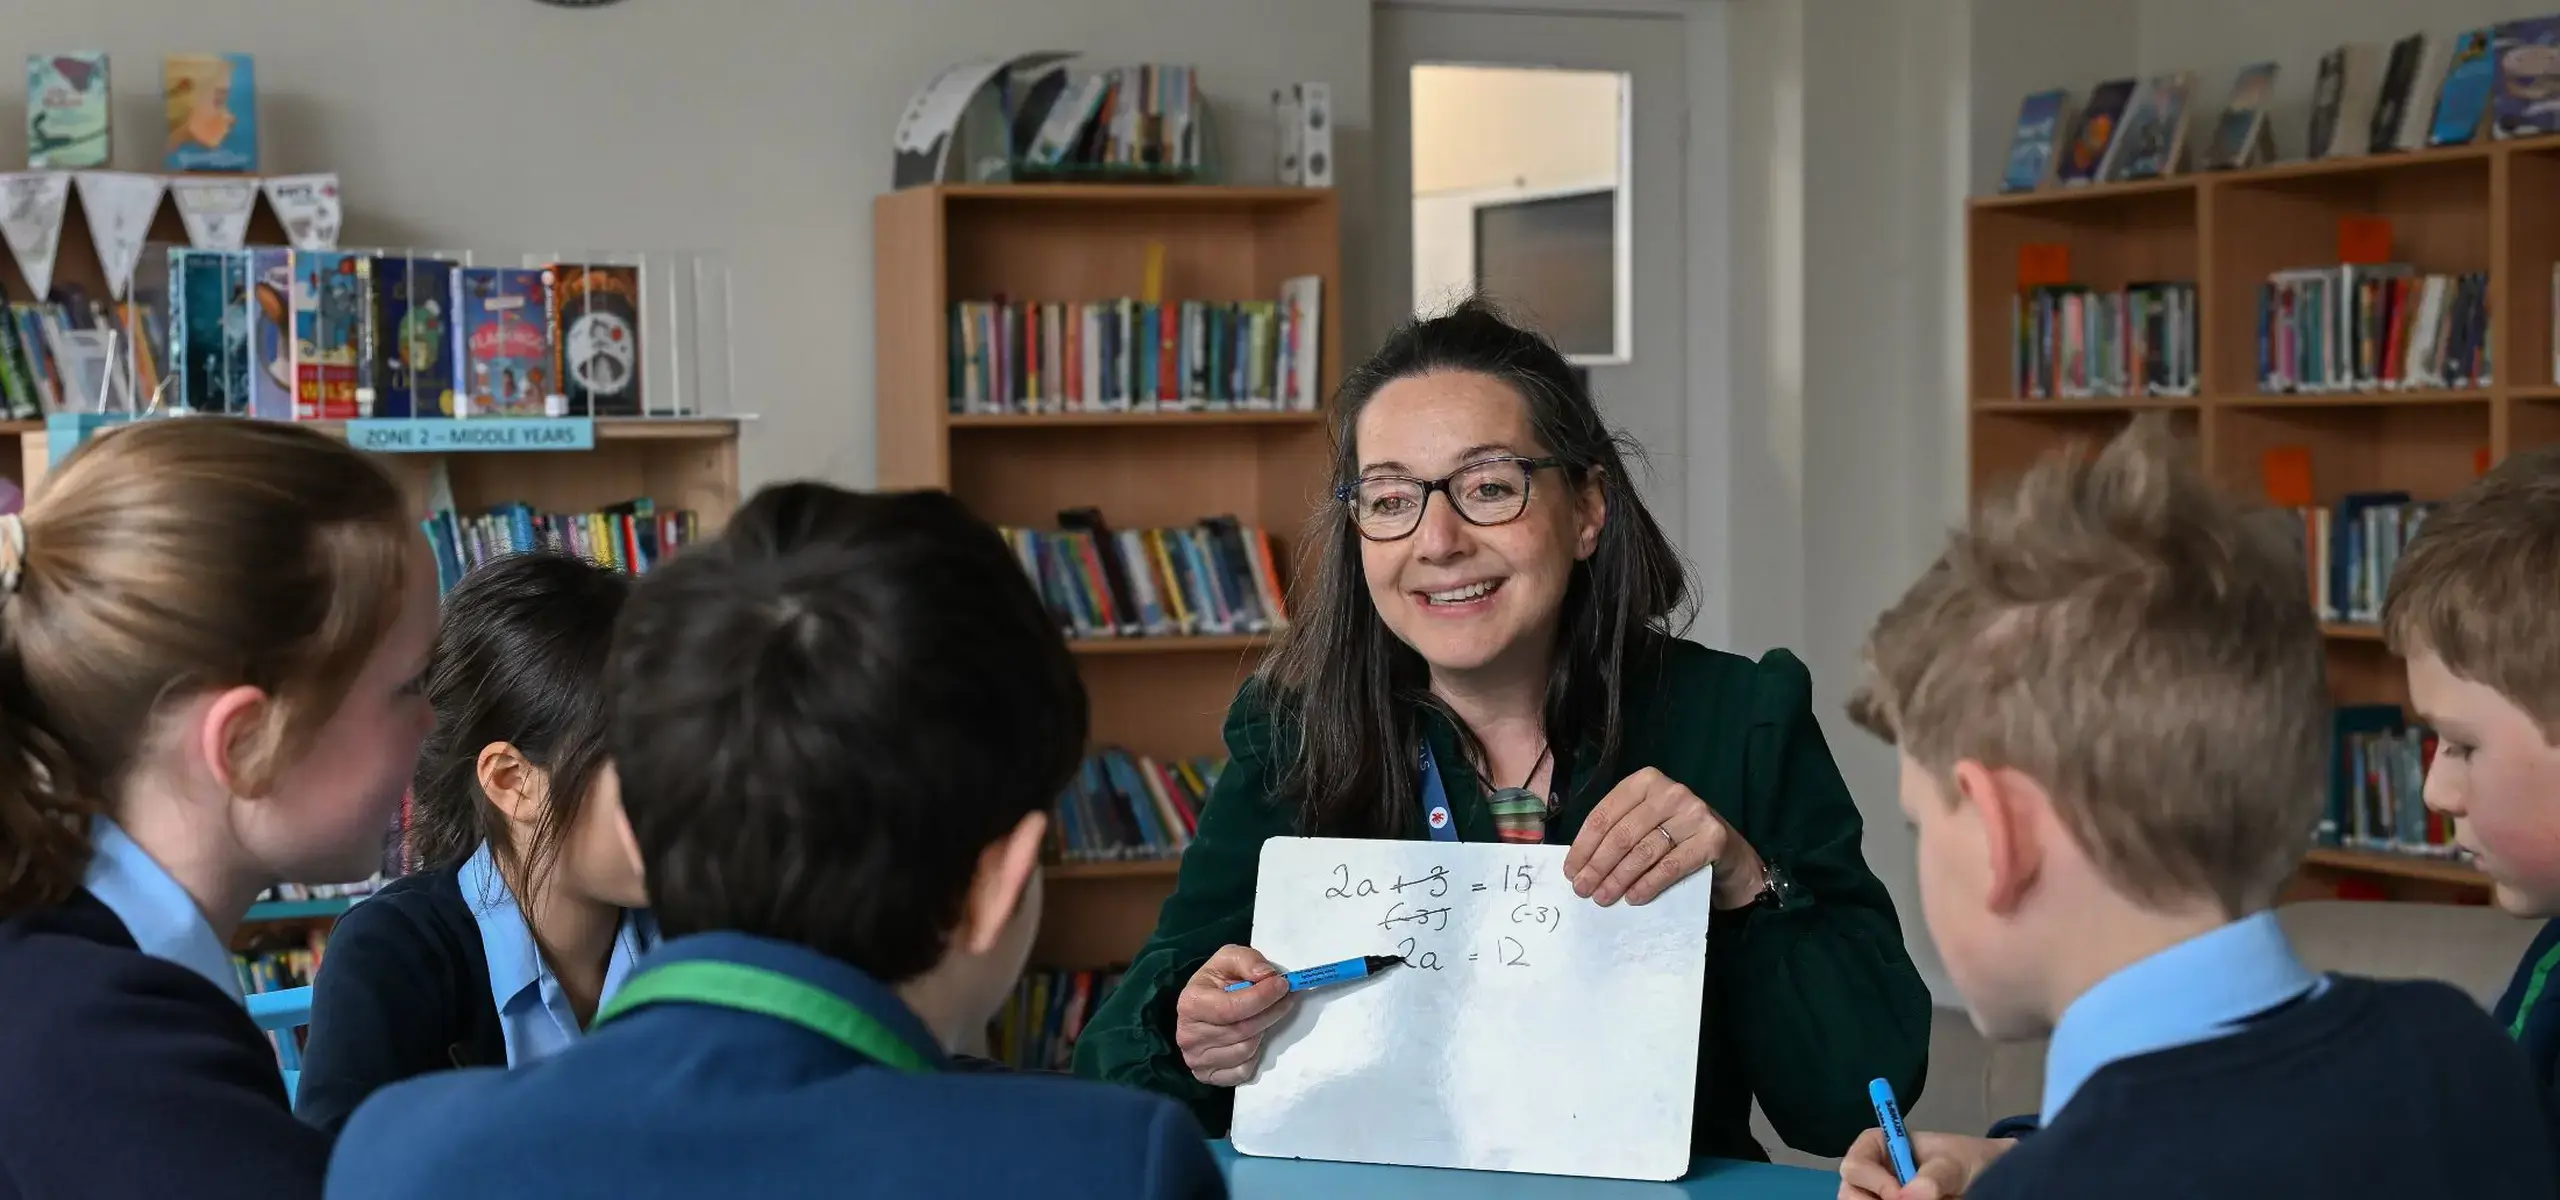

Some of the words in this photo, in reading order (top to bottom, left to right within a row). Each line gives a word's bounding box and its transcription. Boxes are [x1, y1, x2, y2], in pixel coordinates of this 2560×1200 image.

[366, 428, 412, 445] ZONE
[419, 429, 430, 445] 2
[450, 427, 516, 444] MIDDLE
[523, 427, 576, 443] YEARS
[1325, 863, 1379, 899] 2a
[1504, 864, 1534, 893] 15
[1511, 904, 1561, 933] (-3)
[1498, 936, 1531, 967] 12
